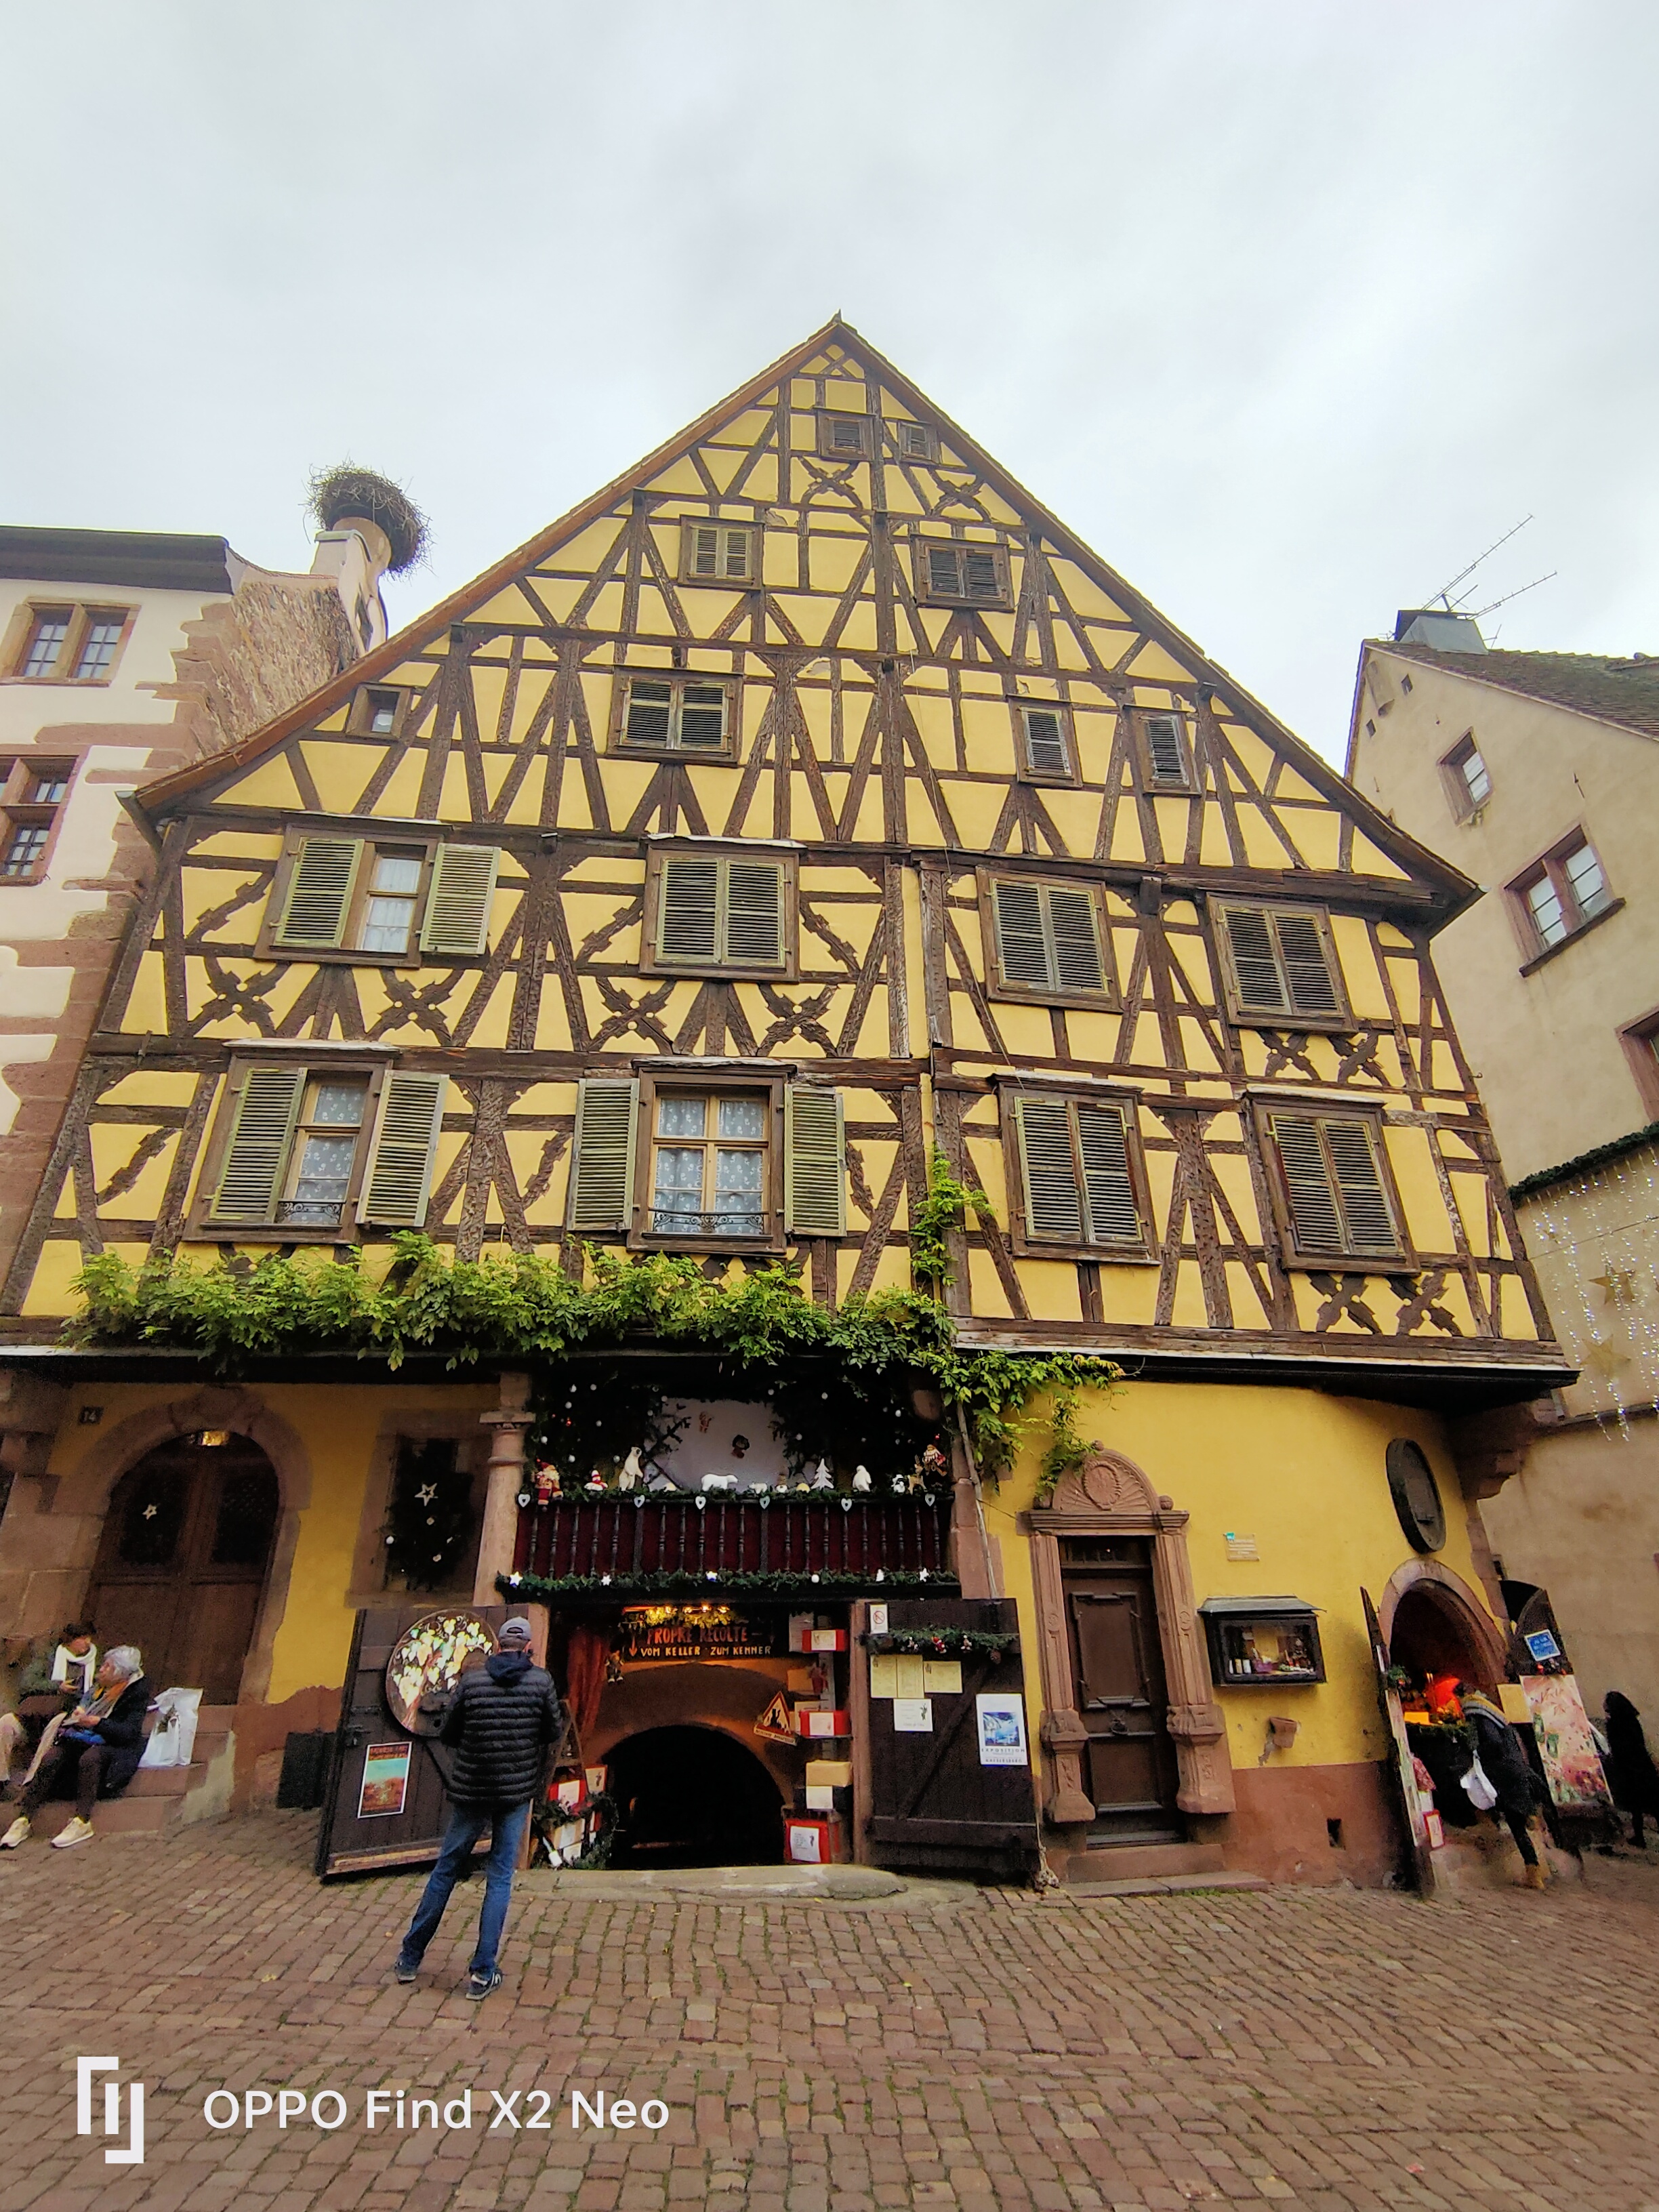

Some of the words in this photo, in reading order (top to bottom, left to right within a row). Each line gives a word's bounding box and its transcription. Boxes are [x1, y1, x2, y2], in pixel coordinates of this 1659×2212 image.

[83, 1410, 96, 1422] 14
[647, 1626, 693, 1644] PROPRE
[640, 1647, 660, 1657] VOM
[665, 1646, 701, 1656] KELLER
[710, 1646, 729, 1656] ZUM
[733, 1645, 771, 1655] KENNER
